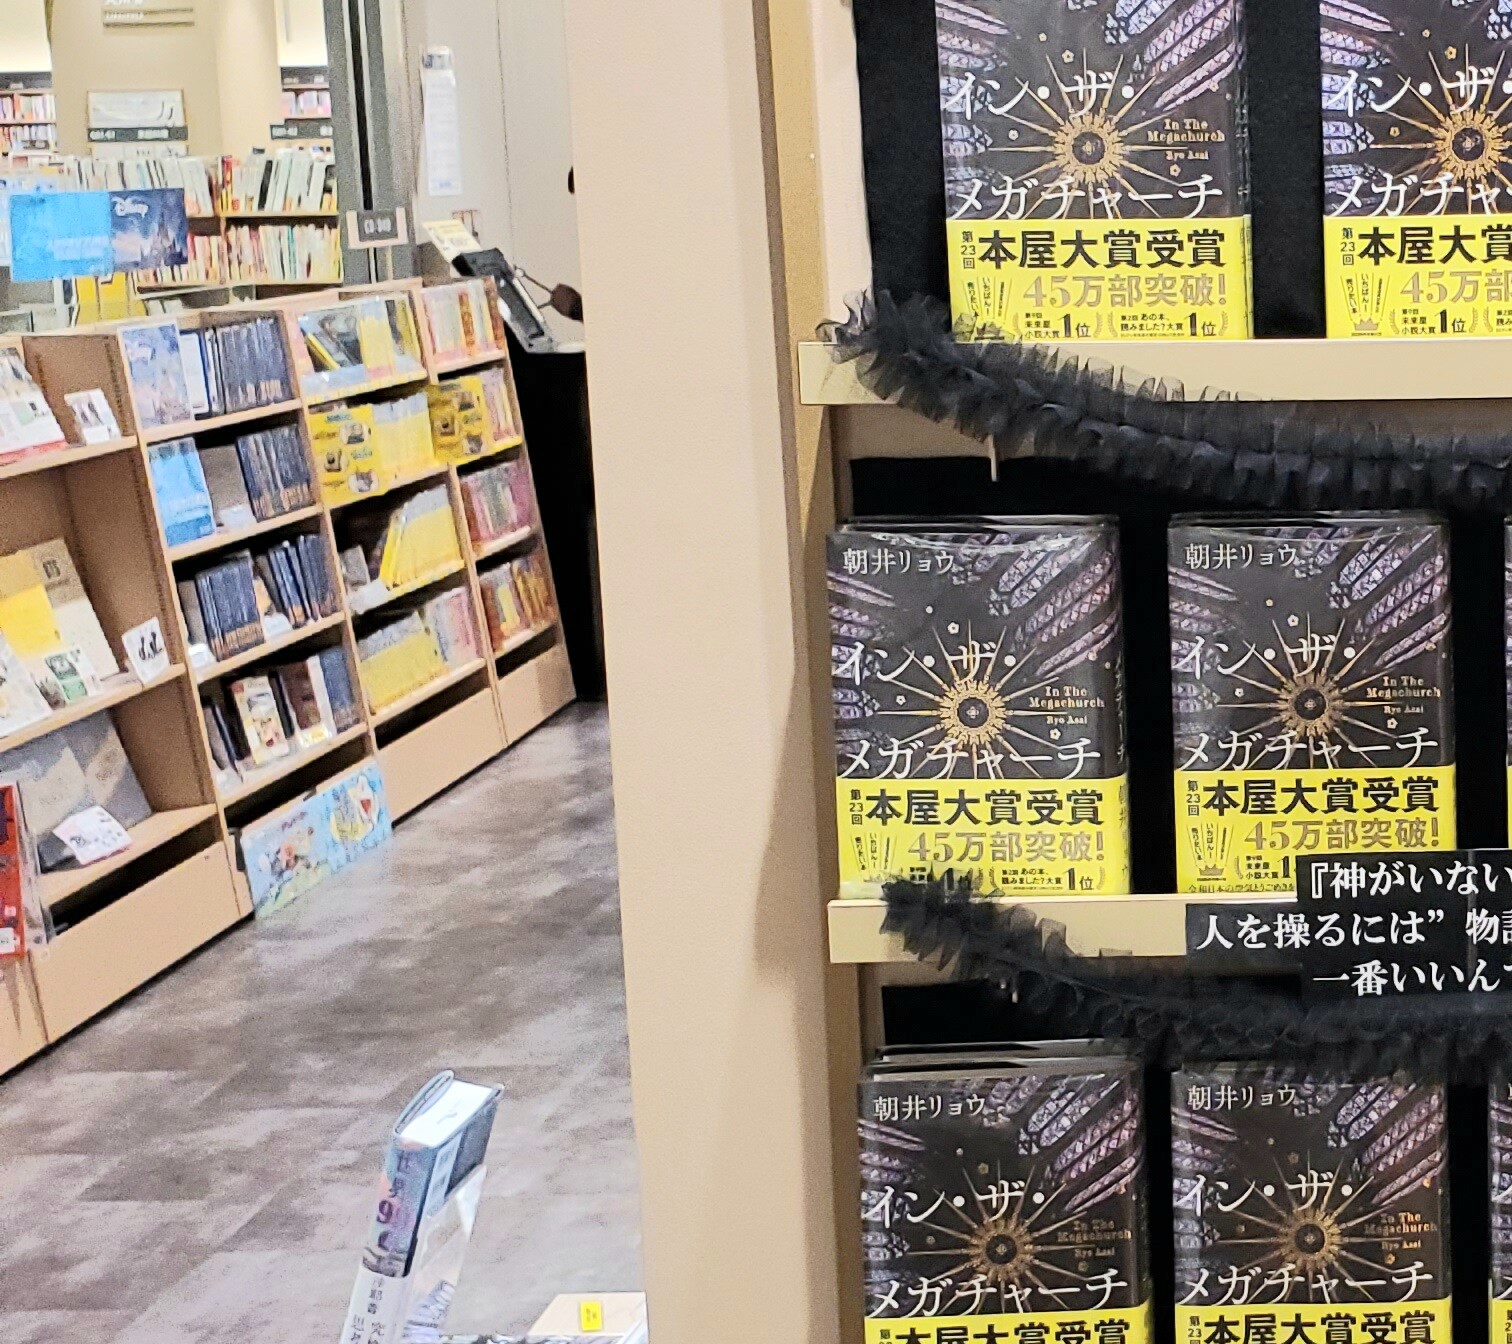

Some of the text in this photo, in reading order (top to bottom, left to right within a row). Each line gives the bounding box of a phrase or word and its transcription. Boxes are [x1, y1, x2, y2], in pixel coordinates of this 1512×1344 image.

[951, 175, 1222, 219] メガチャーチ
[978, 229, 1226, 269] 本屋大賞受賞
[1023, 274, 1227, 308] 45万部突破!
[1203, 777, 1438, 816] 本屋大賞受賞
[1179, 1261, 1433, 1304] メガチャーチ
